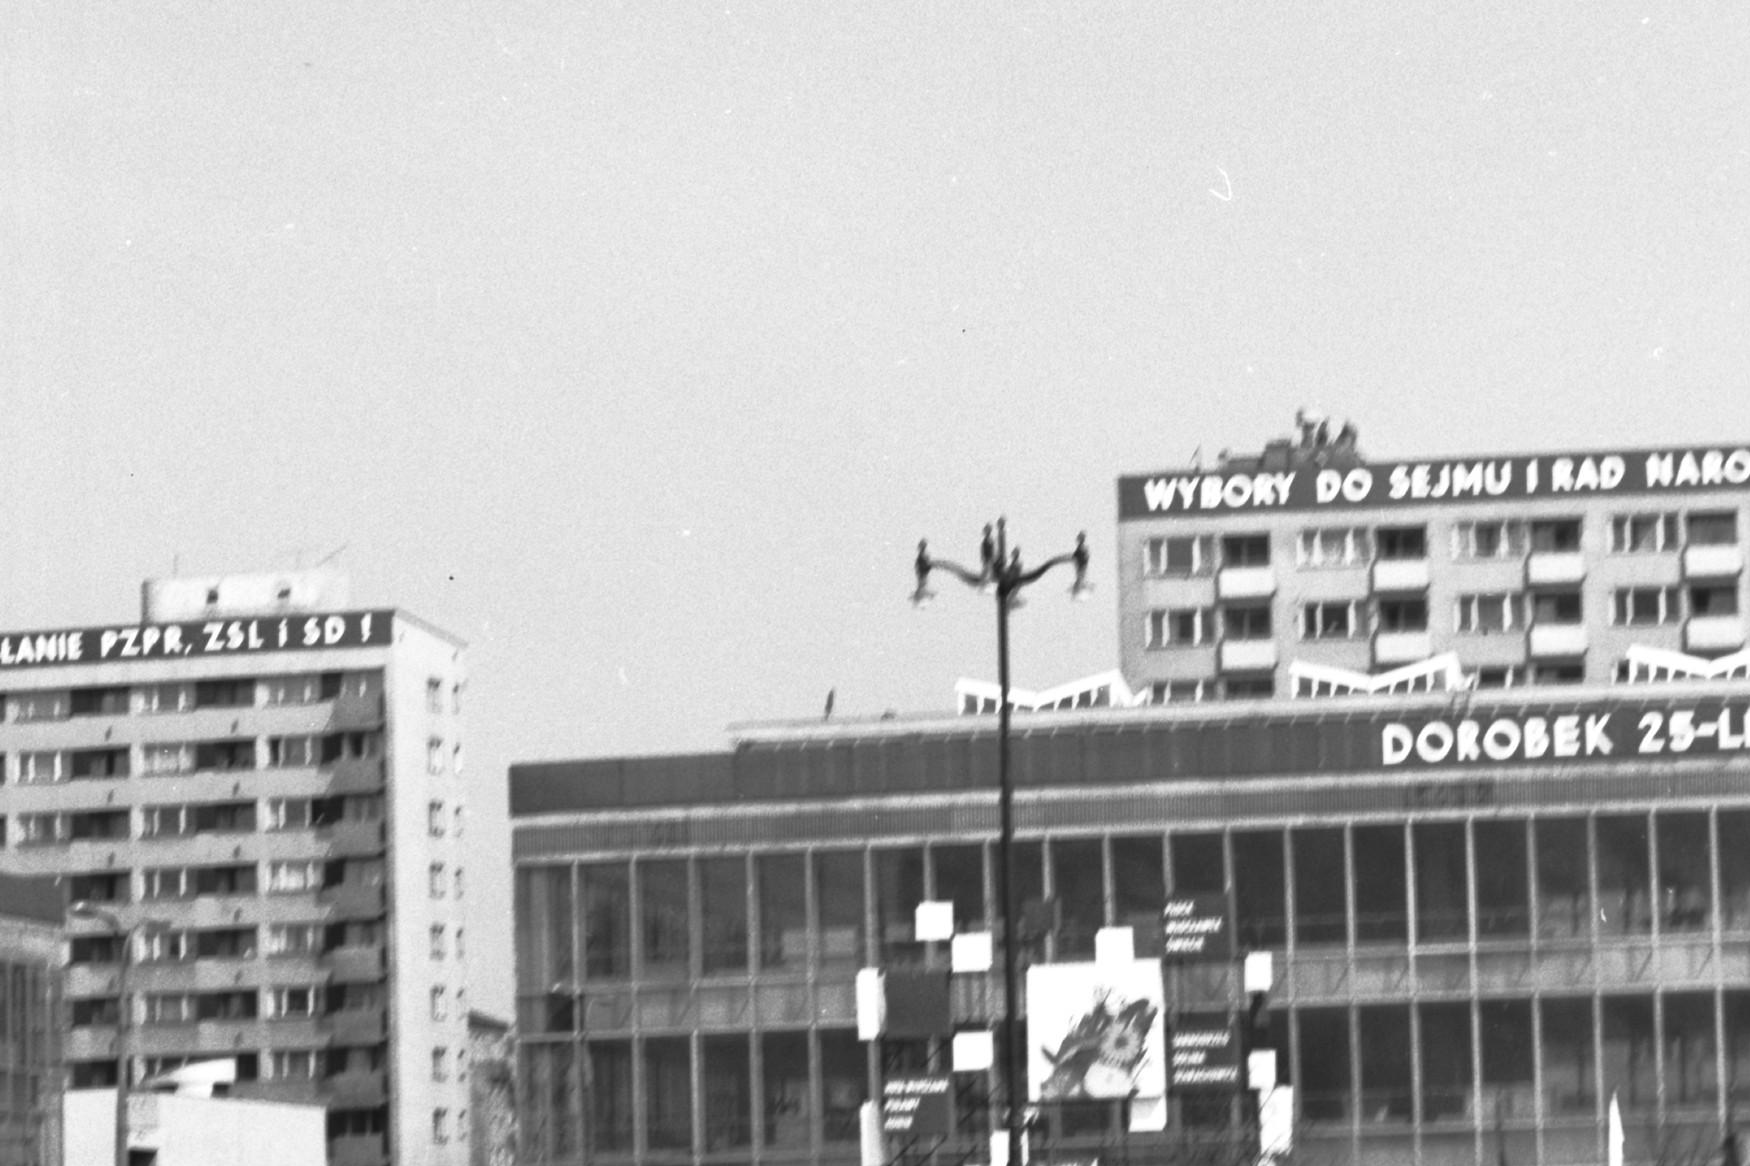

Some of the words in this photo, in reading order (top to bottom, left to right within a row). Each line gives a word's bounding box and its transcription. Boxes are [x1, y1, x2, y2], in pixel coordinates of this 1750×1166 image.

[1143, 470, 1297, 511] WYBORY
[1315, 468, 1373, 503] DO
[1388, 460, 1513, 500] SEJMU
[1525, 457, 1540, 495] I
[1550, 454, 1627, 493] RAD
[201, 619, 265, 653] ZSL
[302, 614, 347, 647] SD
[1381, 710, 1614, 766] DOROBEK
